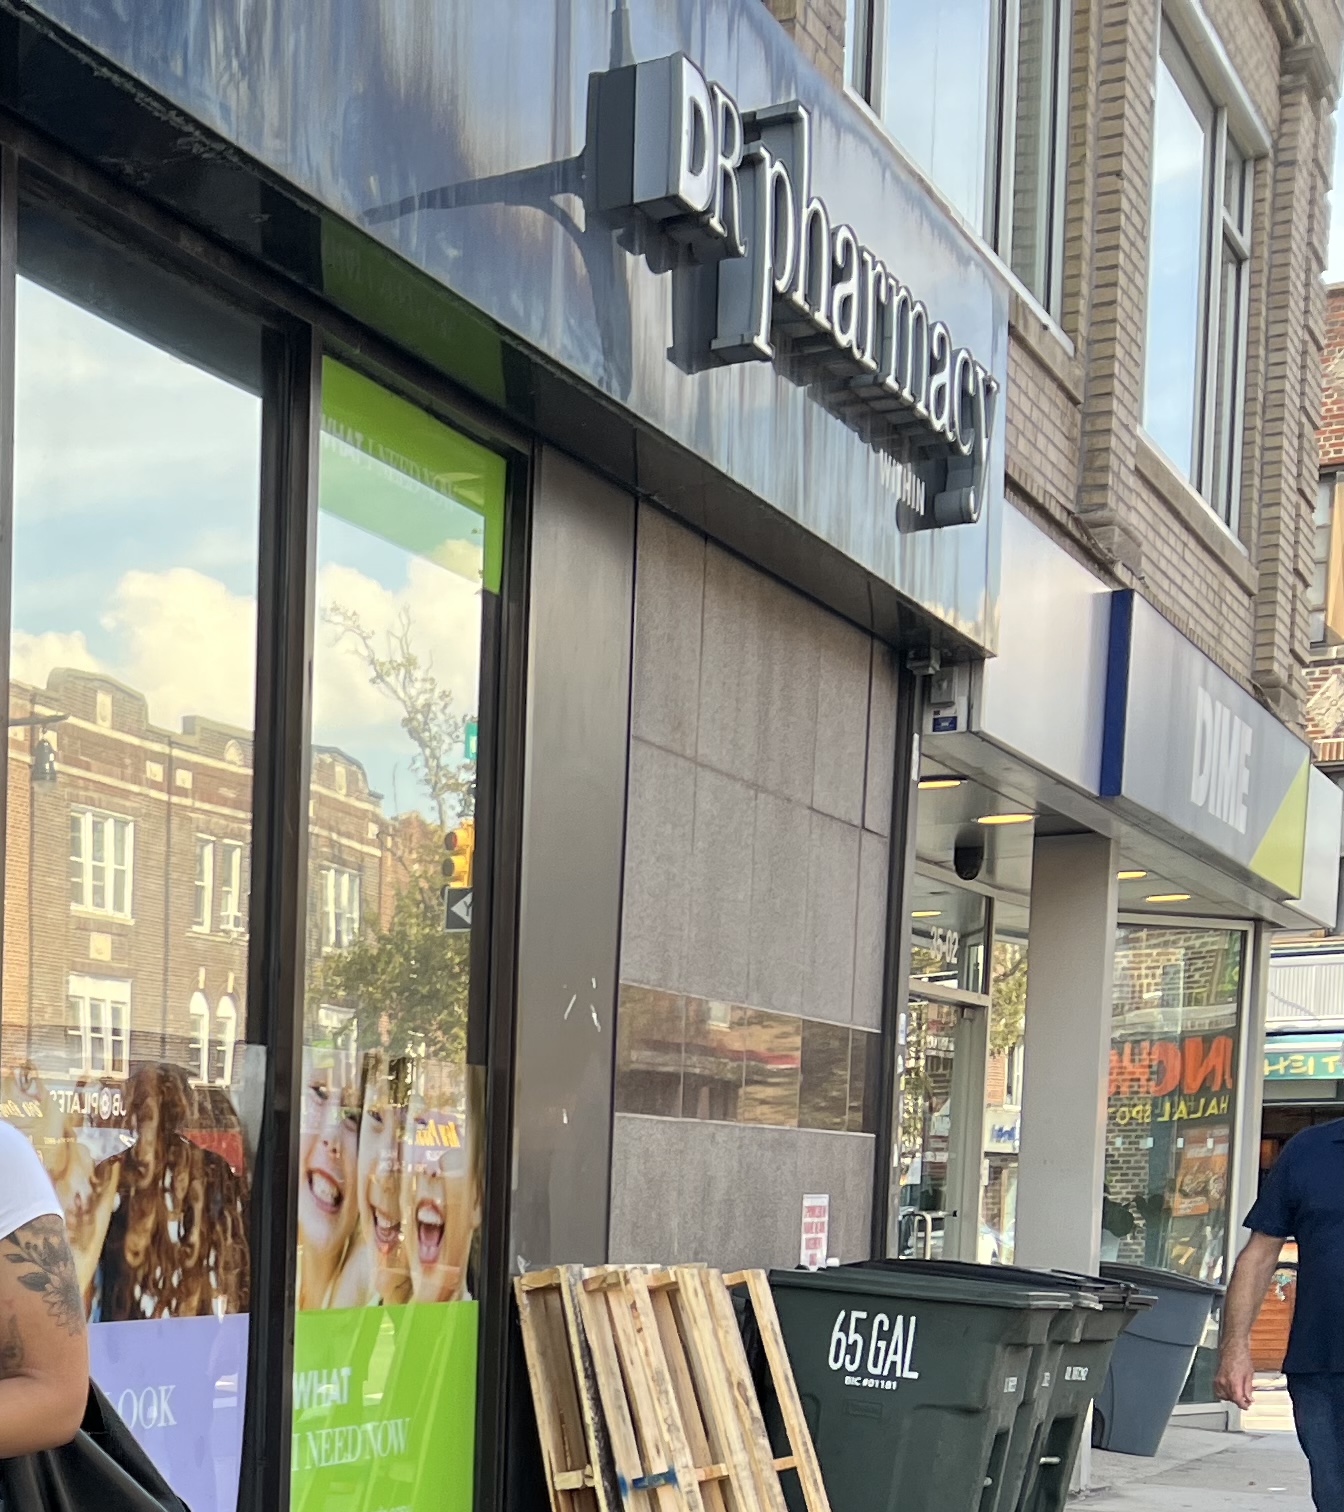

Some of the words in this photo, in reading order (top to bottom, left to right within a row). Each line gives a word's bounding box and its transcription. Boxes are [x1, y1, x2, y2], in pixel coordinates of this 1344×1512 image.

[757, 100, 1000, 524] pharmacy
[879, 448, 926, 516] WITHIN
[1190, 686, 1254, 835] DIME
[828, 1309, 868, 1373] 65
[867, 1313, 920, 1380] GAL
[105, 1384, 178, 1431] OOK
[292, 1366, 353, 1410] WHAT
[305, 1424, 363, 1471] NEED
[363, 1416, 411, 1461] NOW
